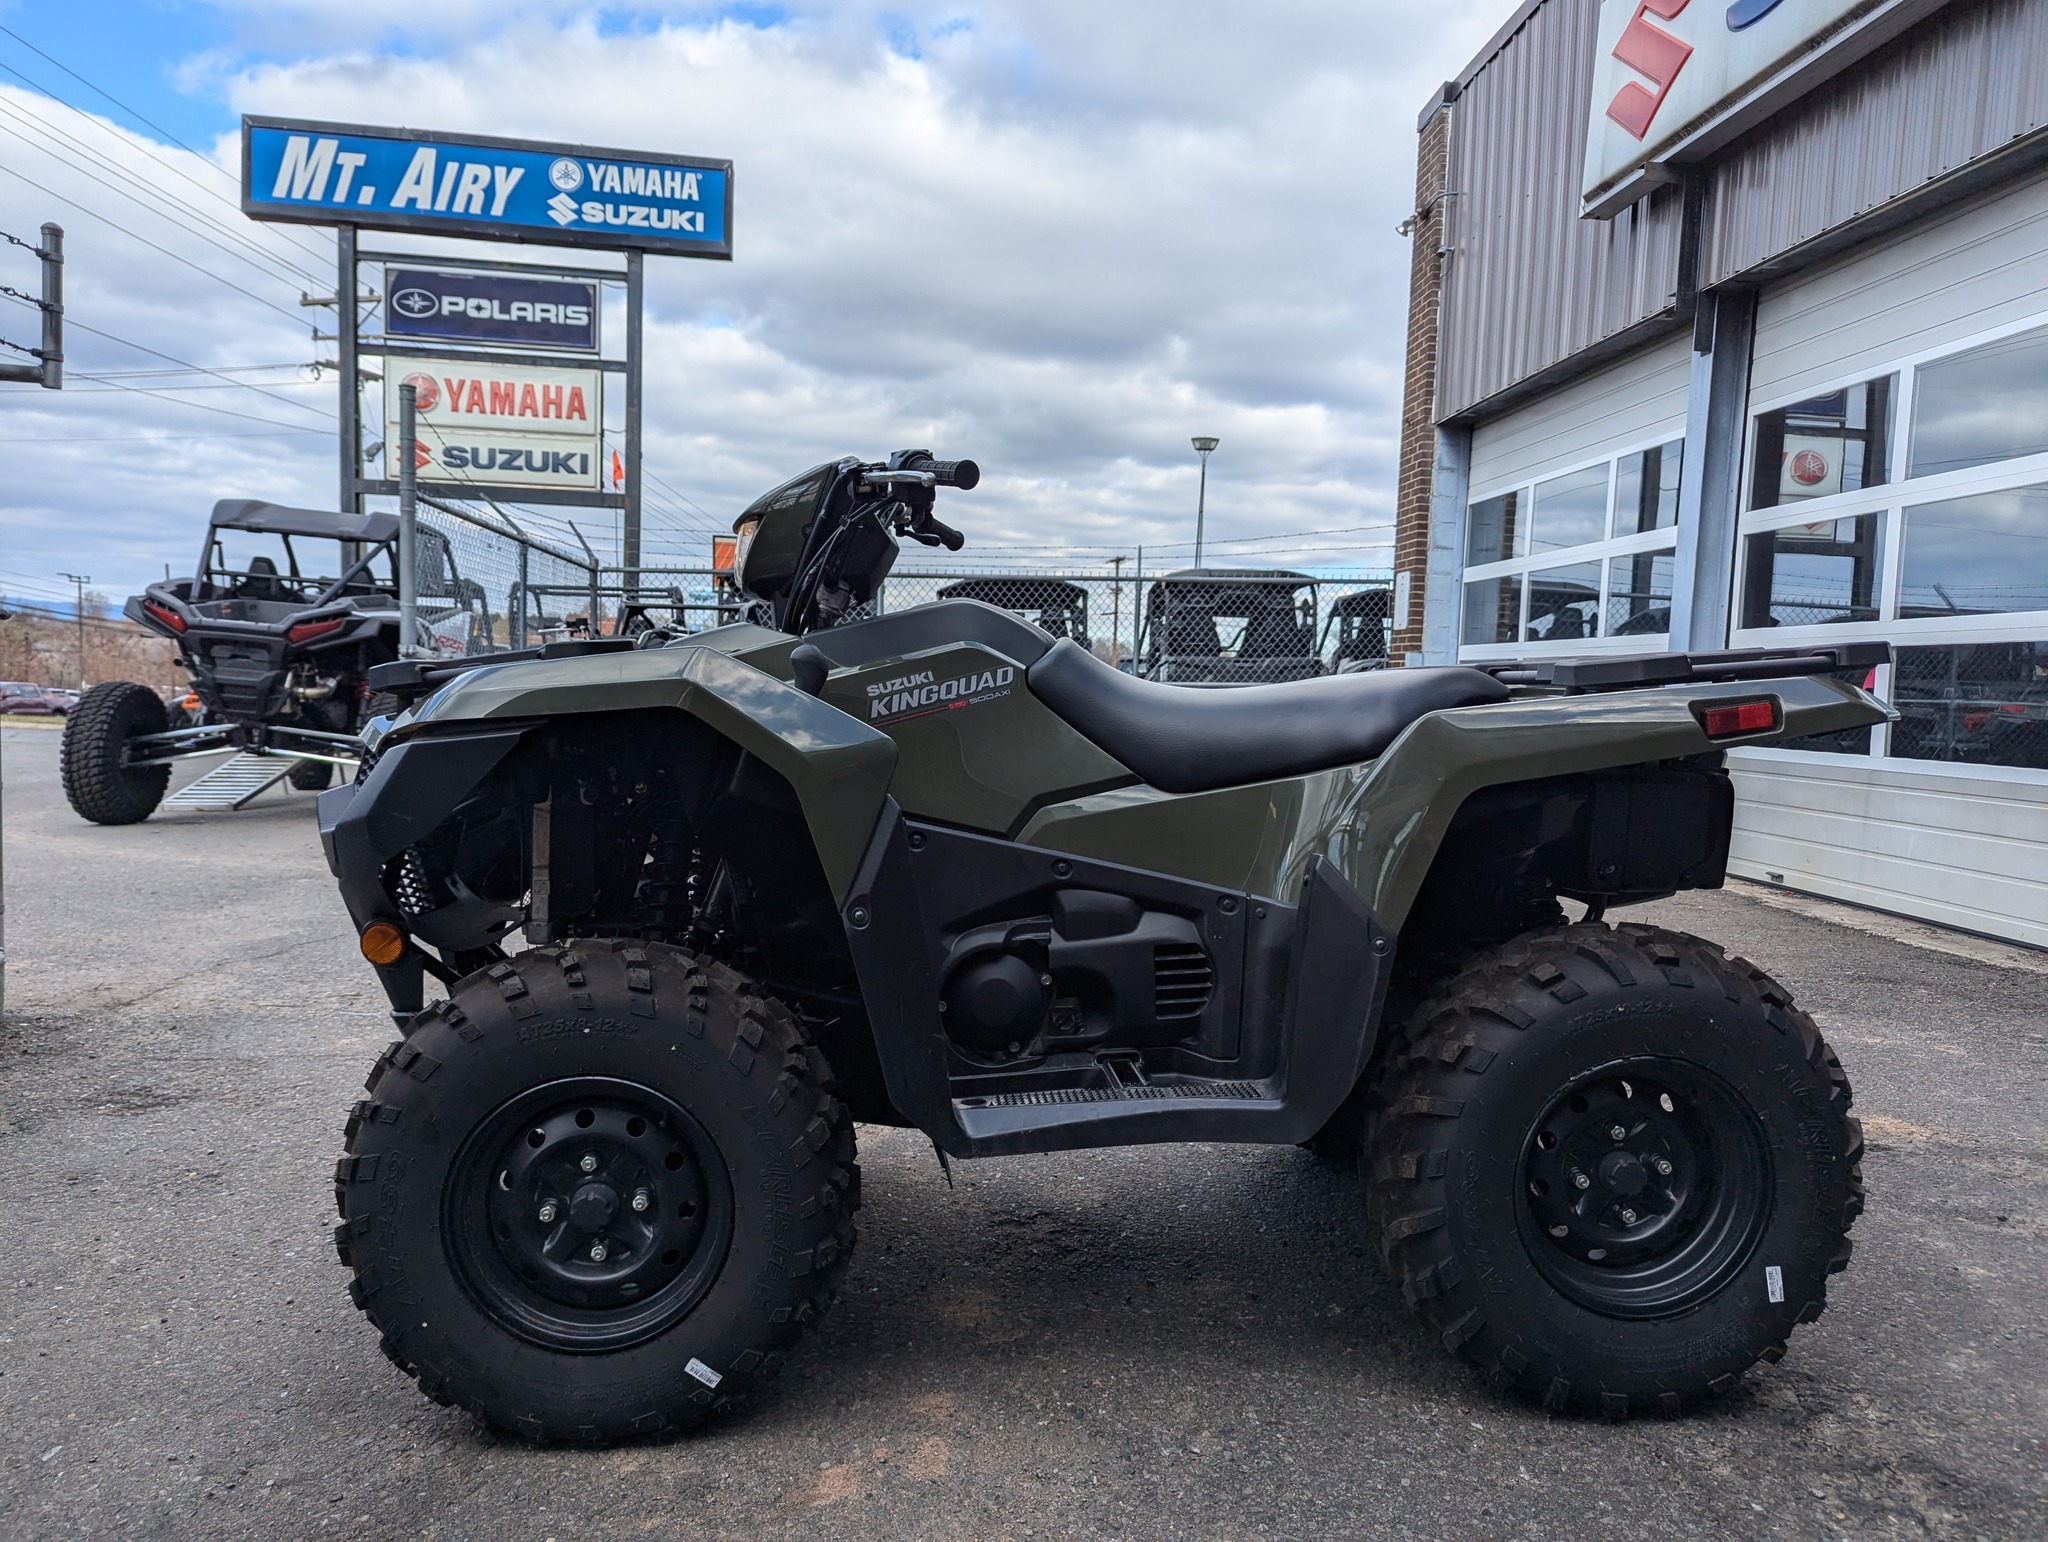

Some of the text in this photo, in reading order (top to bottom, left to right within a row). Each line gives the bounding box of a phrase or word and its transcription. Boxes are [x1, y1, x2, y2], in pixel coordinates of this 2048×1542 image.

[389, 147, 525, 217] AIRY
[586, 162, 700, 202] YAMAHA
[581, 201, 704, 233] SUZUKI
[441, 295, 589, 326] POLARIS
[444, 377, 587, 421] YAMAHA
[442, 446, 589, 475] SUZUKI
[866, 670, 935, 697] SUZUKI
[870, 666, 1014, 719] KINGQUAD
